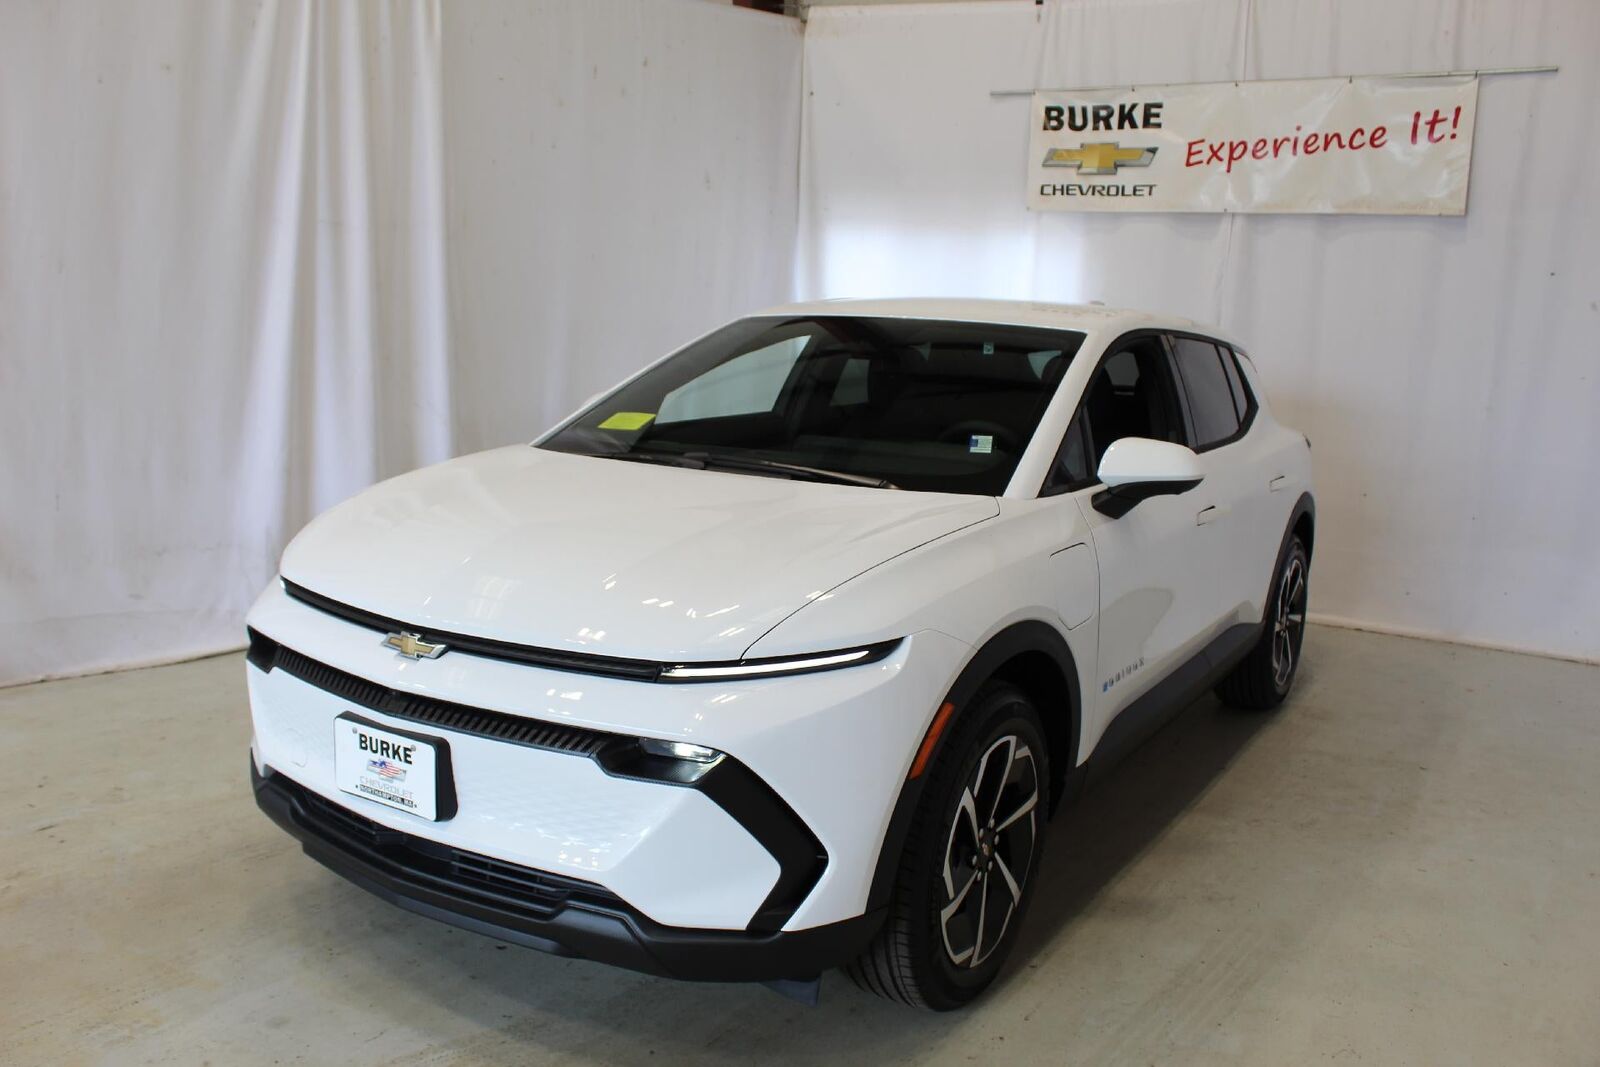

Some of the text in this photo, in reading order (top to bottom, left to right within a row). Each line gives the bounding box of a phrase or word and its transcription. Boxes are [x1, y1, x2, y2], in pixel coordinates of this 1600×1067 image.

[1042, 102, 1163, 131] BURKE
[1185, 106, 1461, 173] Experience It!
[1040, 184, 1157, 197] CHEVROLET
[359, 733, 412, 765] BURKE
[359, 775, 414, 800] CHEVROLET
